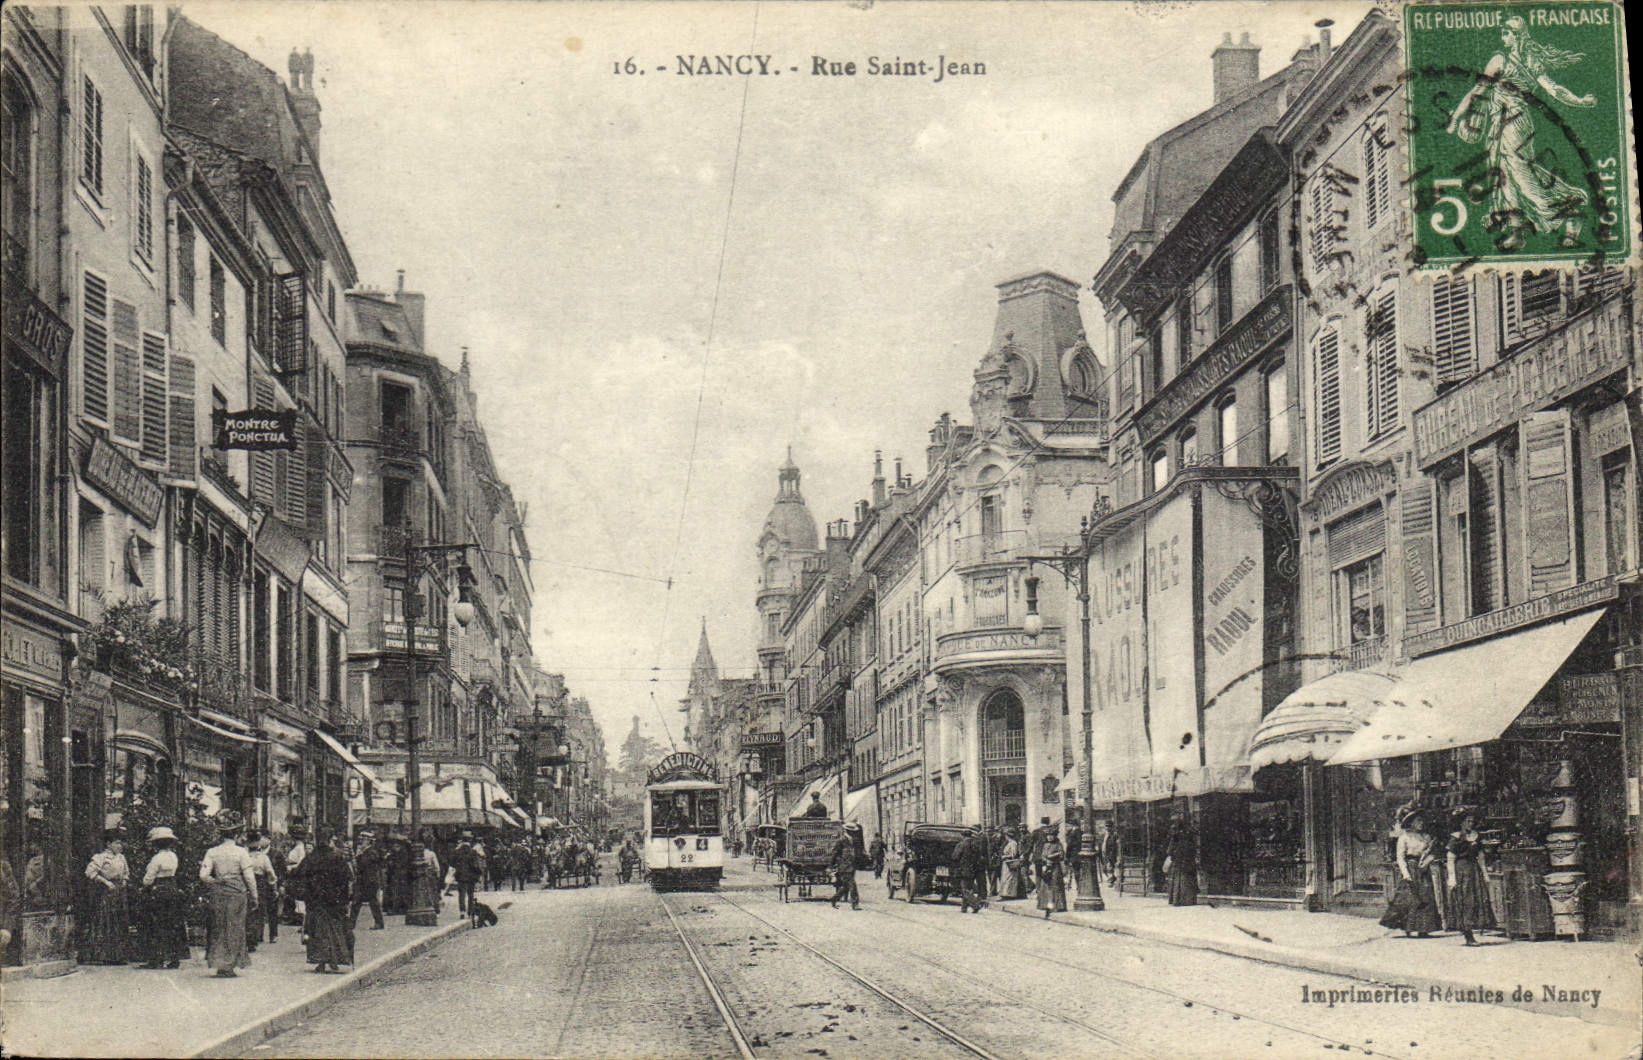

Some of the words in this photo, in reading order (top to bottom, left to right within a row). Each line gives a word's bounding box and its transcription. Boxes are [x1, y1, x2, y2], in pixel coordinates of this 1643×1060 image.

[1530, 8, 1611, 27] FRANÇAISE
[1417, 387, 1481, 462] BUREAU
[1511, 302, 1623, 417] PLACEMENT
[225, 418, 281, 431] MONTRE
[1206, 606, 1258, 656] RAOUL
[652, 752, 715, 779] BENEDICTINE
[698, 839, 707, 849] 4
[680, 854, 694, 863] 22
